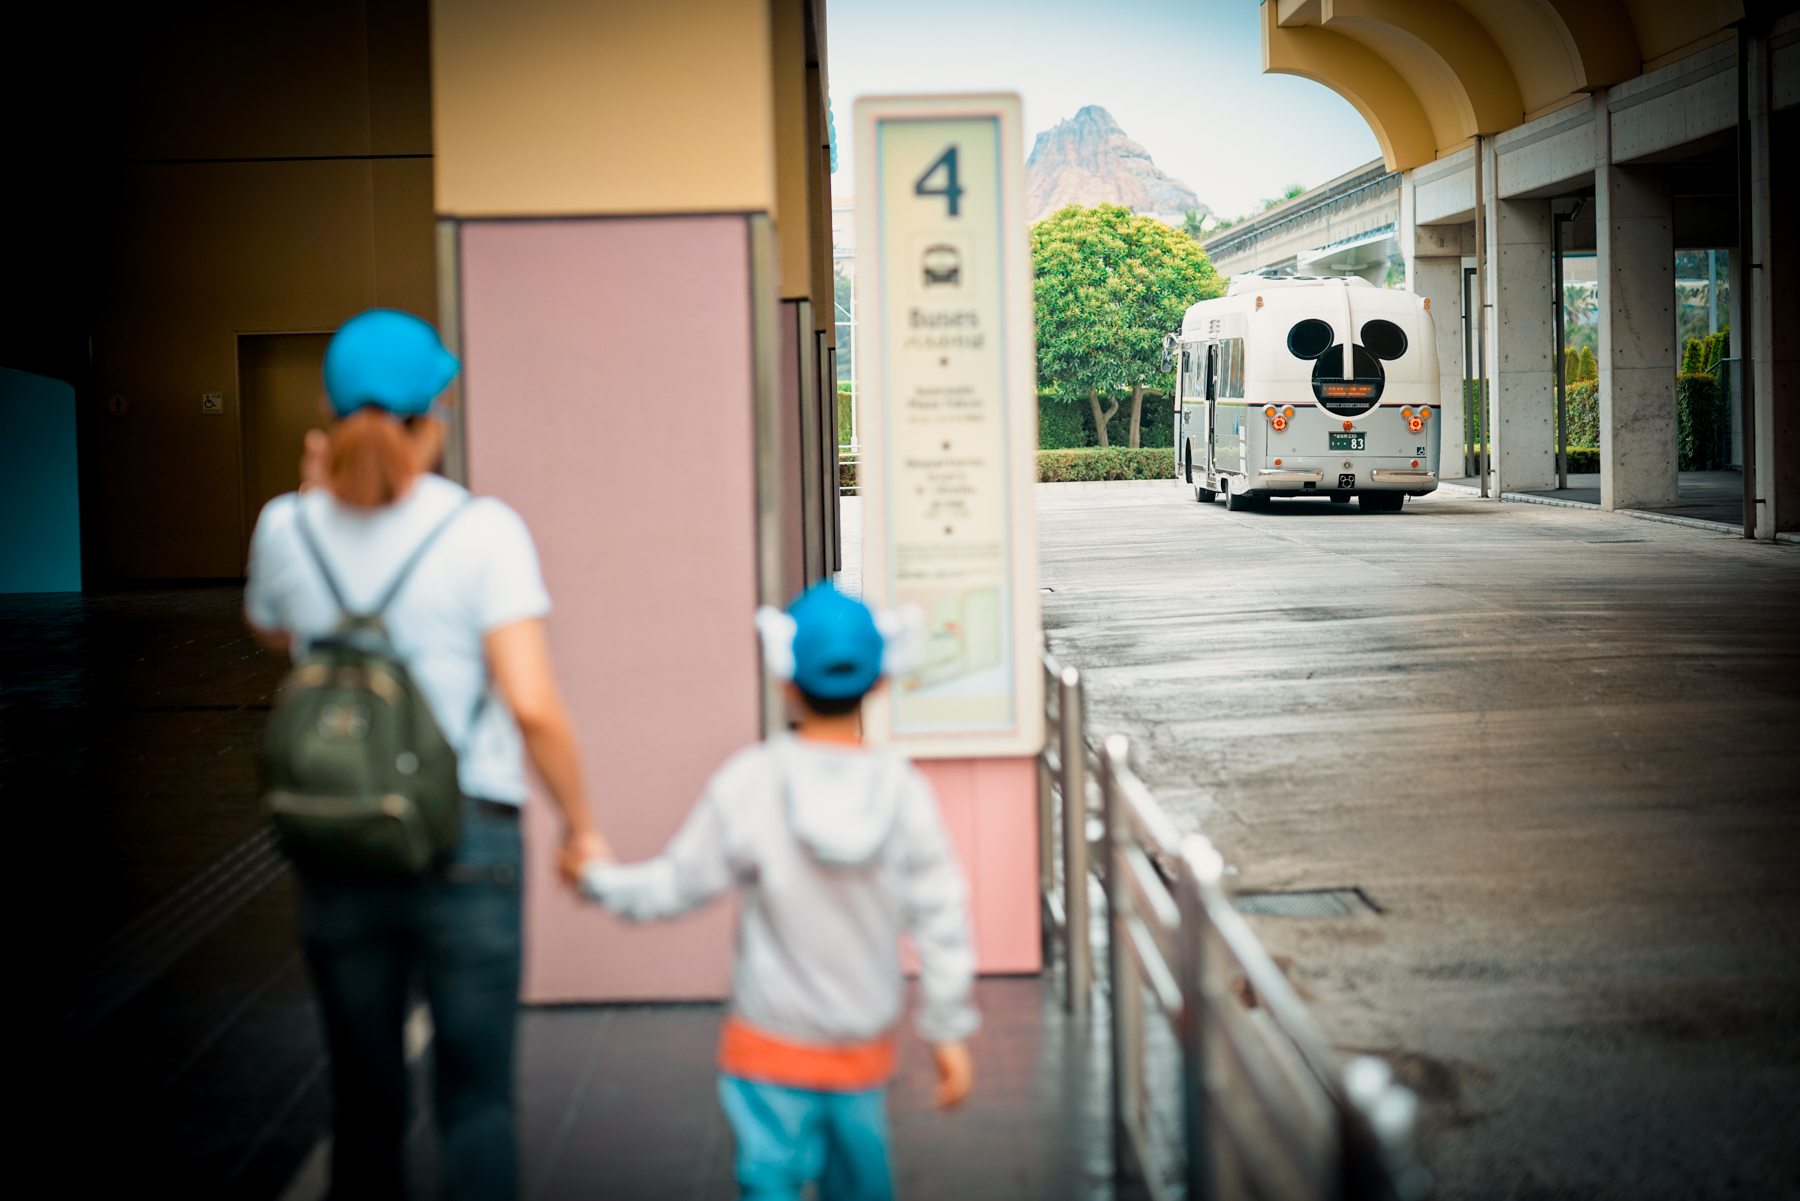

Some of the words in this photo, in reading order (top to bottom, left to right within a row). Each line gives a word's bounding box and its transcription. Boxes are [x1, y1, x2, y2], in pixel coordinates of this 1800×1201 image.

[914, 143, 964, 217] 4
[908, 307, 979, 328] Buses
[1351, 438, 1364, 449] 83
